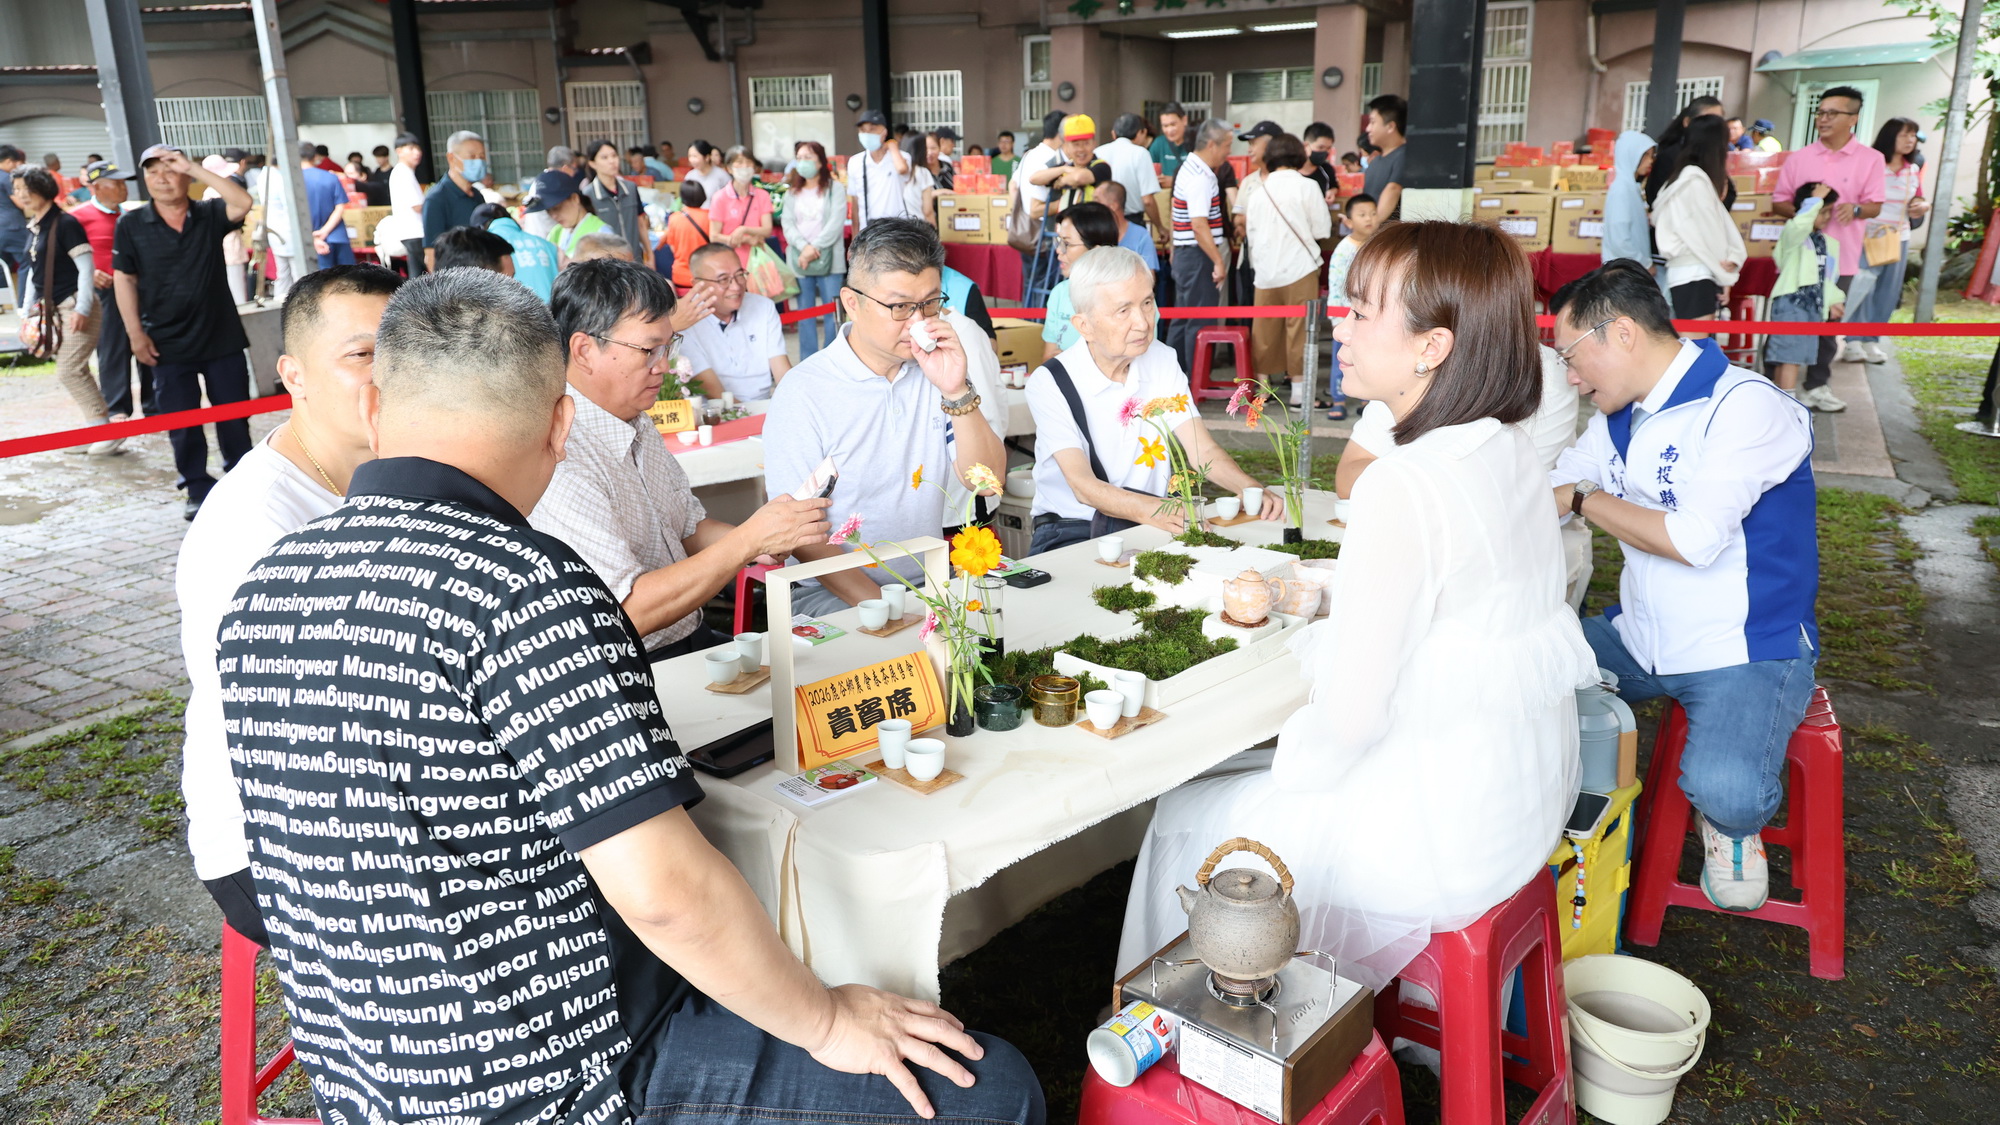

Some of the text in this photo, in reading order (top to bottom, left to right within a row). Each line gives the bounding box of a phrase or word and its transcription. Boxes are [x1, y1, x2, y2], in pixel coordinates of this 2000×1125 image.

[650, 412, 680, 425] 賓席
[1656, 444, 1679, 508] 南投縣
[276, 539, 384, 559] Munsingwear
[344, 513, 476, 541] Munsingwear
[314, 559, 437, 590] Munsingwear
[249, 593, 352, 616] Munsingwear
[355, 590, 476, 638] Munsingwe
[491, 585, 612, 636] Munsingwe
[299, 618, 416, 654] Munsingwear
[472, 617, 588, 686] Munsingw
[242, 654, 338, 680] Munsingwear
[342, 654, 451, 693] Munsingw
[515, 642, 637, 695] Munsingwe
[294, 684, 410, 720] Munsingwear
[826, 687, 917, 739] 貴賓席
[547, 699, 659, 753] Munsingwe
[536, 732, 648, 799] Munsingw
[429, 811, 545, 840] singwear
[302, 879, 430, 907] Munsingwea
[361, 898, 526, 935] Munsingwear
[453, 898, 598, 960] unsingwear
[376, 949, 538, 994] Munsingwear
[473, 954, 610, 1014] unsingwear
[389, 1010, 553, 1055] Munsingwear
[483, 1010, 619, 1076] unsingwear
[399, 1067, 572, 1115] Munsingwear
